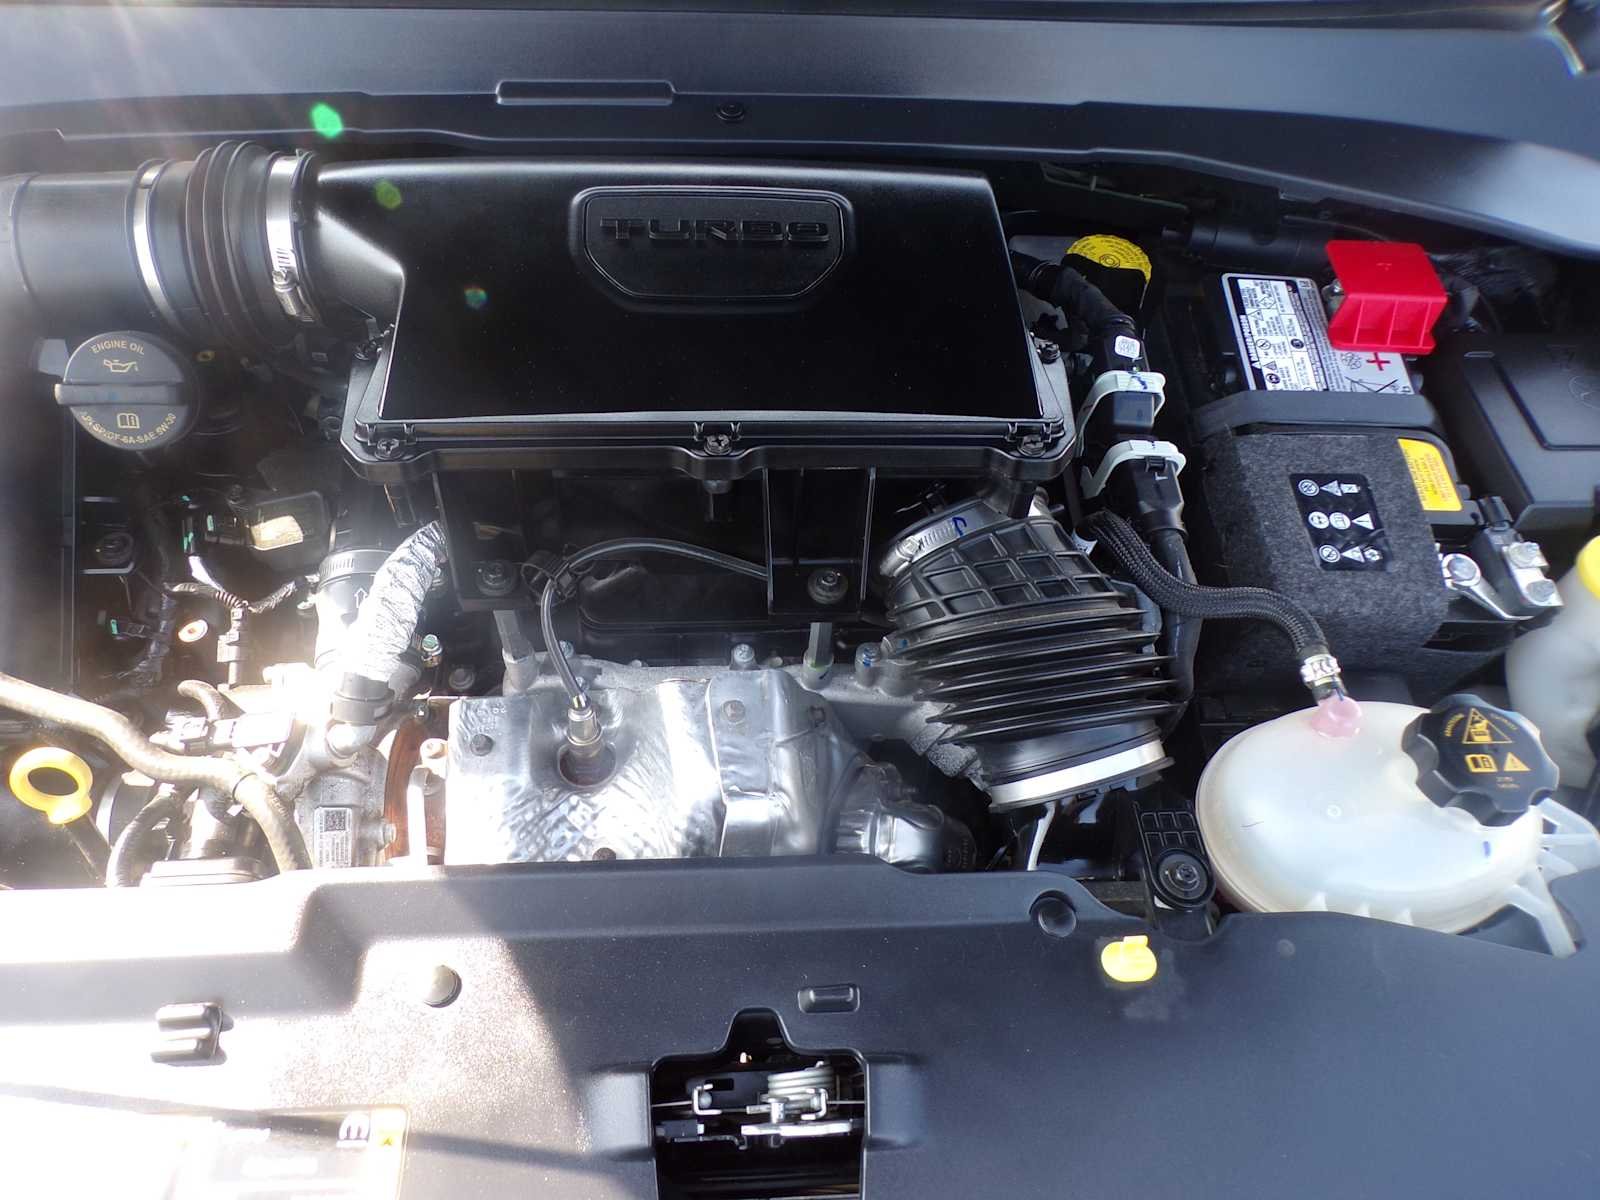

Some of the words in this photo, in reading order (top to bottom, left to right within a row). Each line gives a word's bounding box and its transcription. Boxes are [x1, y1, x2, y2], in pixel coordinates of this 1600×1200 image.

[600, 217, 830, 242] TURBO
[90, 340, 127, 354] ENGINE
[129, 342, 145, 355] OIL
